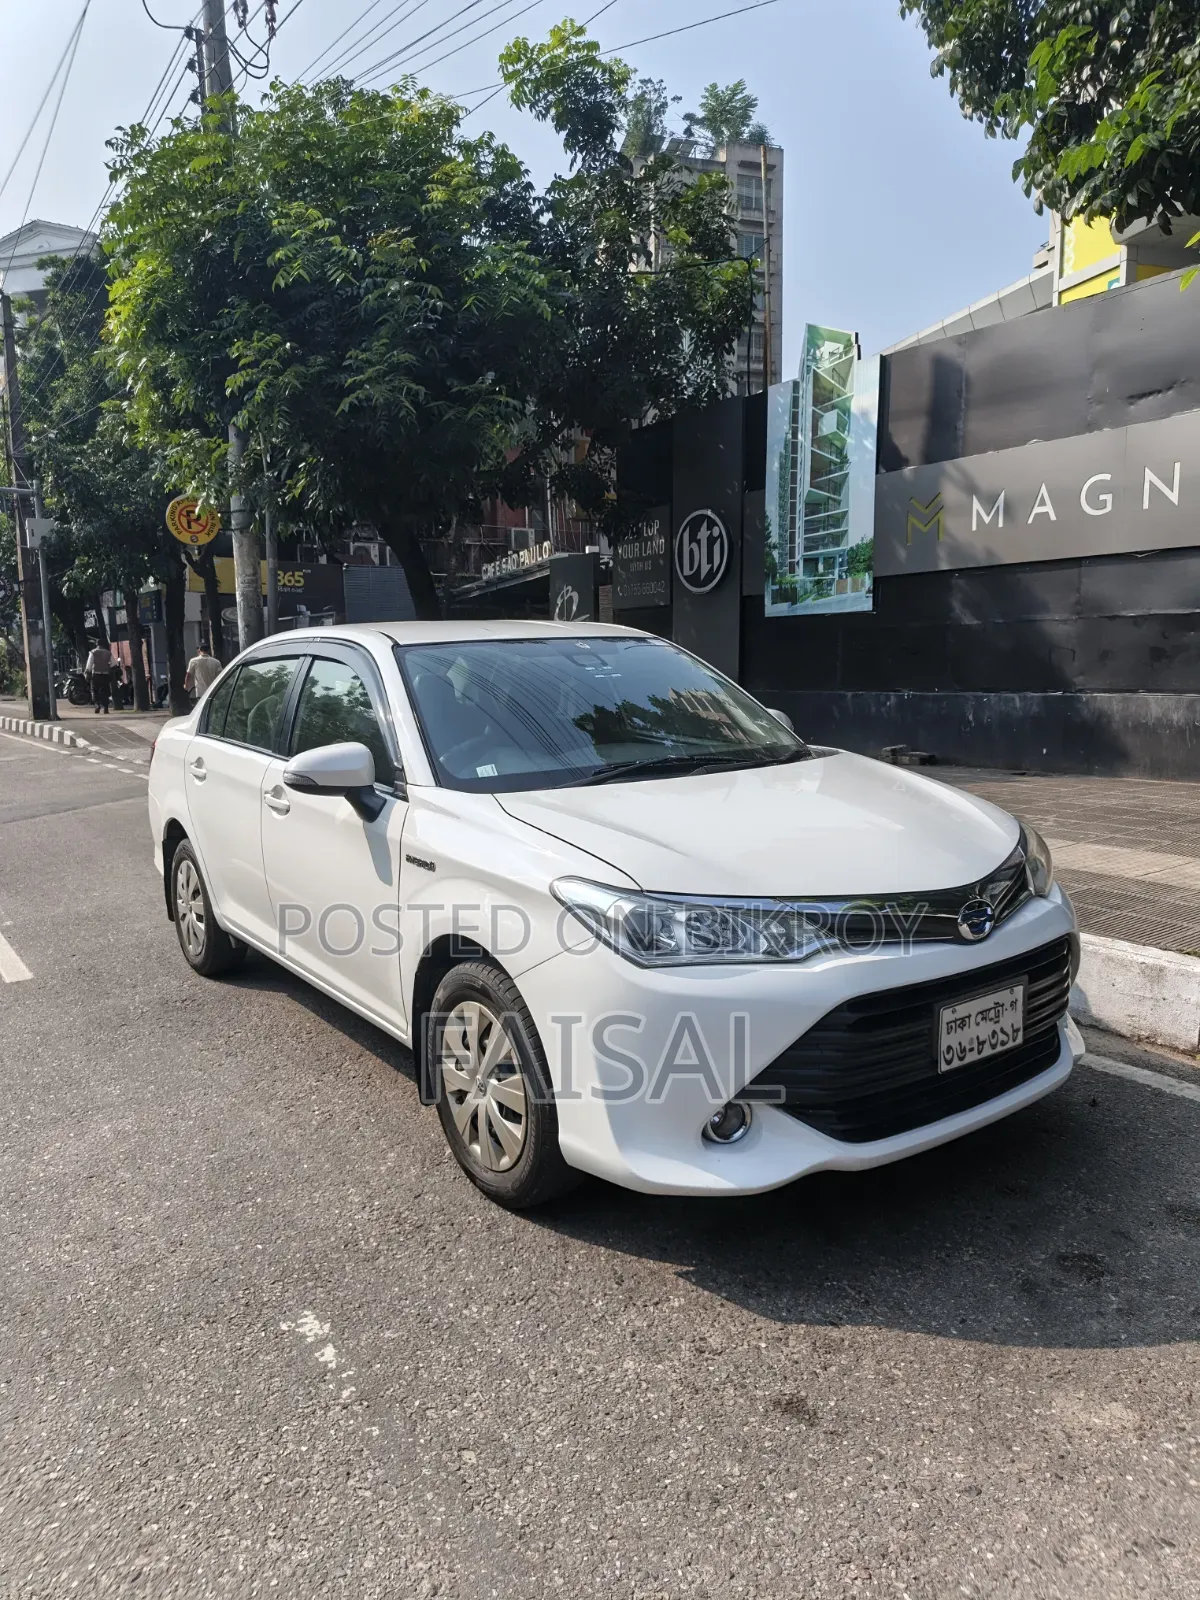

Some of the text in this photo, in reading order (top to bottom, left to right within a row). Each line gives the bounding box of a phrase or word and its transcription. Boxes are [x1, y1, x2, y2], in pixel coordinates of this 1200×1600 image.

[971, 461, 1181, 532] MAGN
[169, 505, 183, 536] PARKING
[204, 522, 217, 537] RISK
[519, 540, 552, 568] PAULO
[617, 538, 666, 559] YOUR LAND
[682, 517, 721, 582] bti
[644, 560, 652, 571] US
[277, 570, 305, 587] 365
[945, 1013, 972, 1035] ঢাকা
